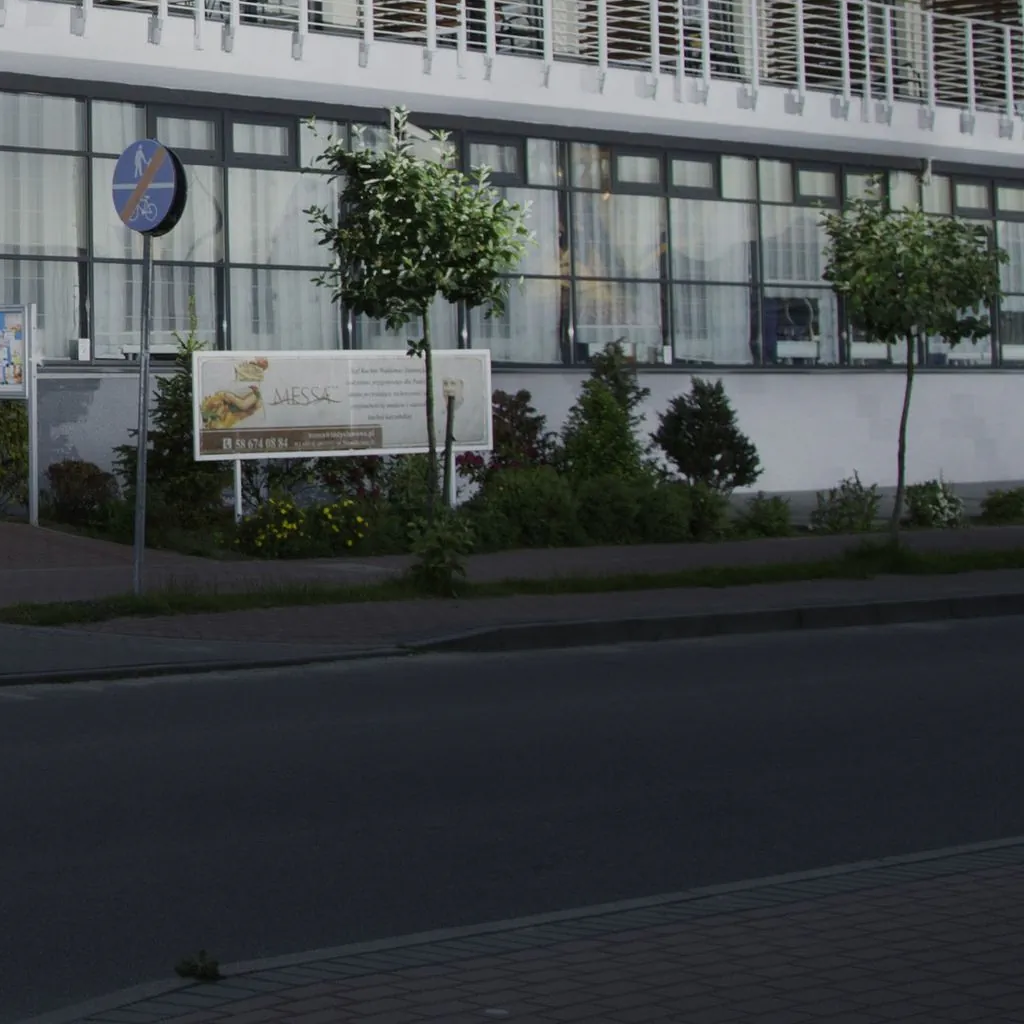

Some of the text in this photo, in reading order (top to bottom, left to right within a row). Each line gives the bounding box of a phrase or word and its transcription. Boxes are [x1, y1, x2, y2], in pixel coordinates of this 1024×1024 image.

[236, 439, 246, 449] 58
[248, 438, 263, 449] 674
[265, 437, 276, 448] 08
[277, 437, 288, 448] 84
